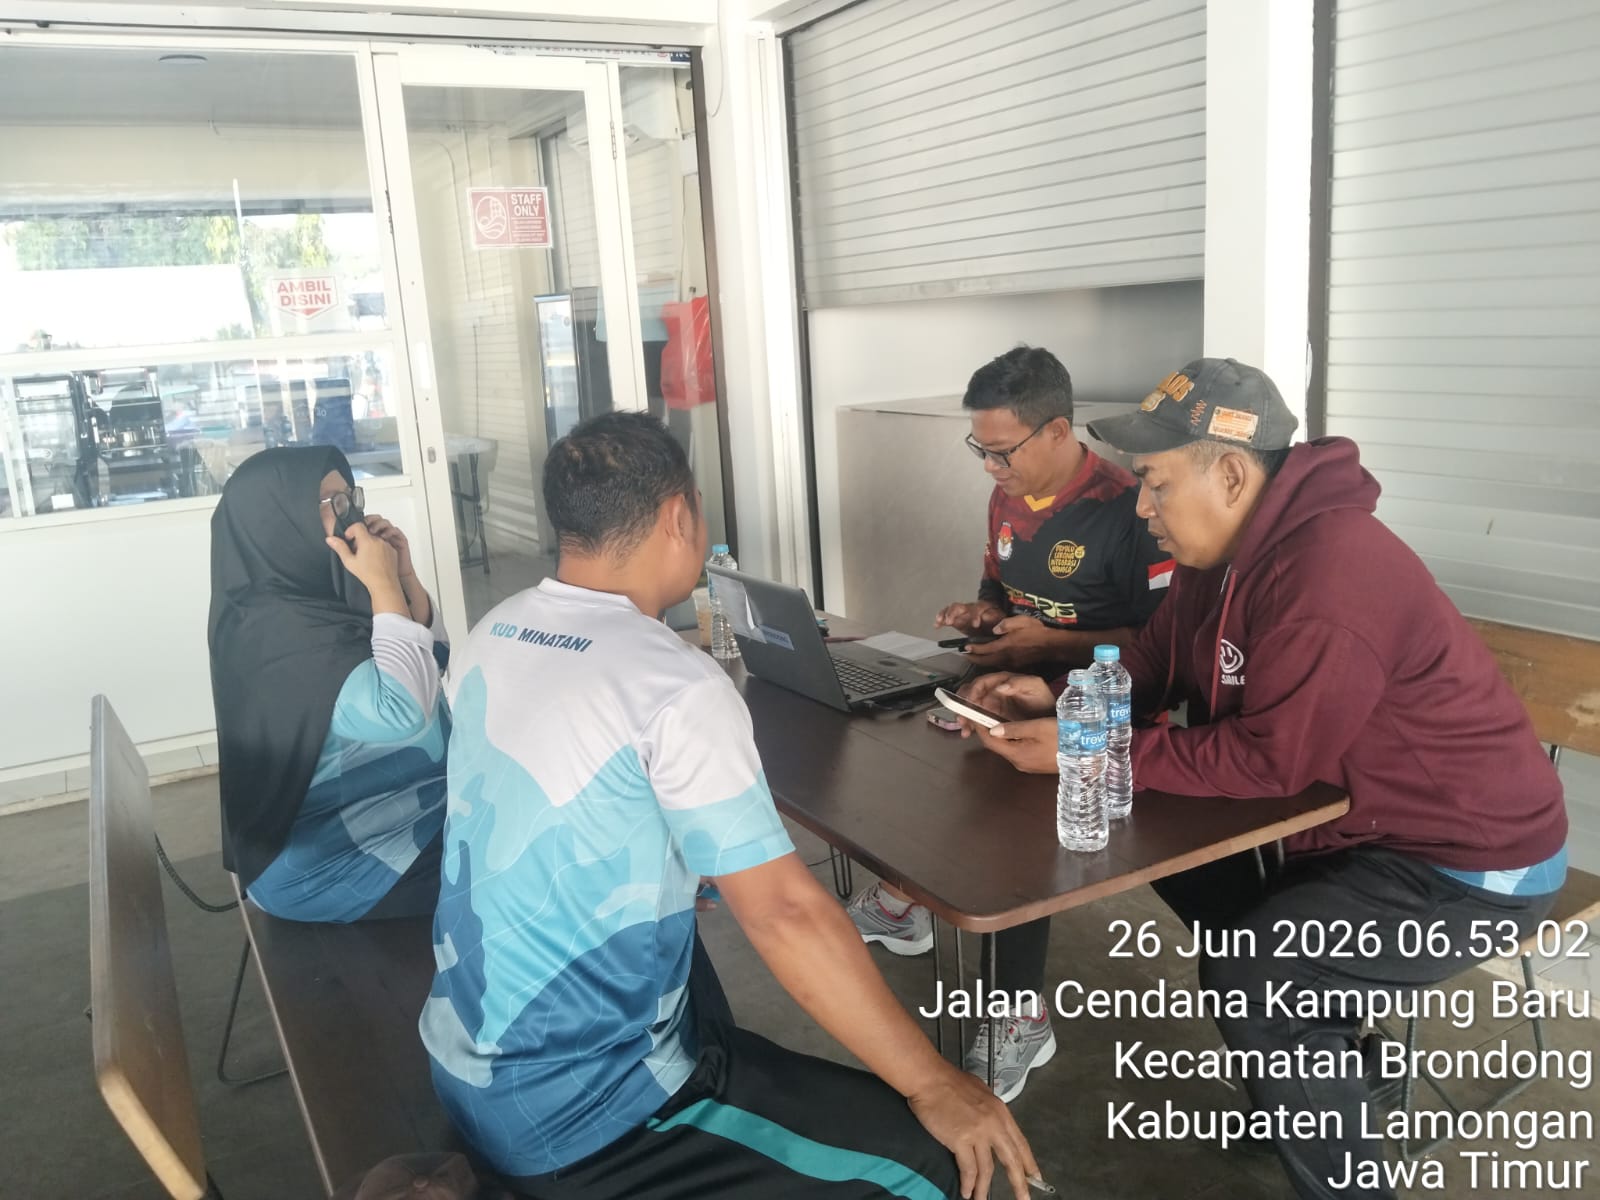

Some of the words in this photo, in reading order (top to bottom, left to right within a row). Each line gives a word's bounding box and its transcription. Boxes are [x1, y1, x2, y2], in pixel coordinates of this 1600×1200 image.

[511, 193, 542, 205] STAFF
[514, 205, 540, 217] ONLY
[277, 280, 332, 294] AMBIL
[280, 293, 332, 307] DISINI
[489, 622, 518, 639] KUD
[517, 627, 593, 653] MINATANI
[1221, 674, 1246, 686] SMILE
